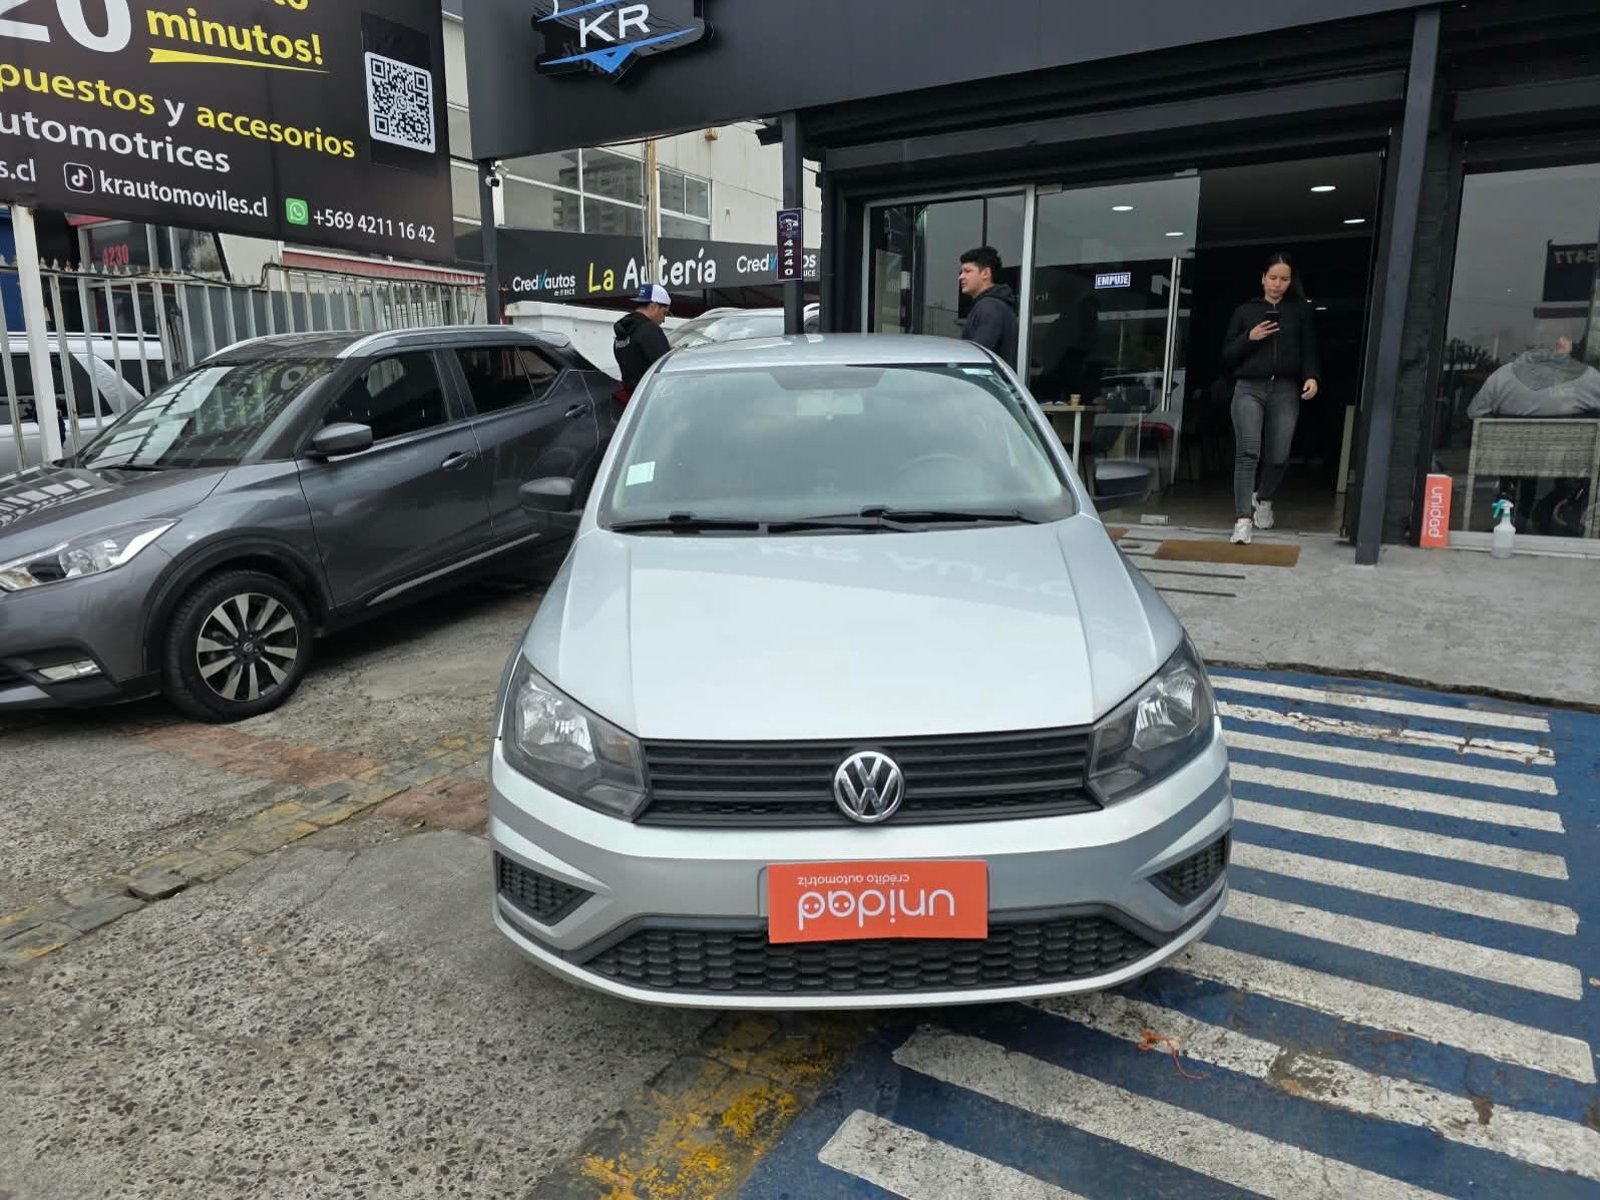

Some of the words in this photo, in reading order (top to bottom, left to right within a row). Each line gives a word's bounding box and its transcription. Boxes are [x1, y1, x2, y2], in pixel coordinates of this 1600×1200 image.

[146, 7, 324, 66] minutos!
[579, 4, 651, 48] KR
[164, 99, 185, 127] y
[197, 106, 355, 158] accesorios
[99, 170, 269, 218] krautomoviles.cl
[313, 208, 354, 231] +569
[357, 215, 393, 237] 4211
[399, 221, 416, 240] 16
[418, 225, 436, 244] 42
[588, 262, 615, 293] La
[783, 239, 794, 276] 4240
[1096, 274, 1129, 287] EMPUJE
[1428, 486, 1445, 538] unidad
[797, 874, 865, 887] automotriz
[866, 873, 910, 885] crédito
[798, 888, 956, 931] unidad
